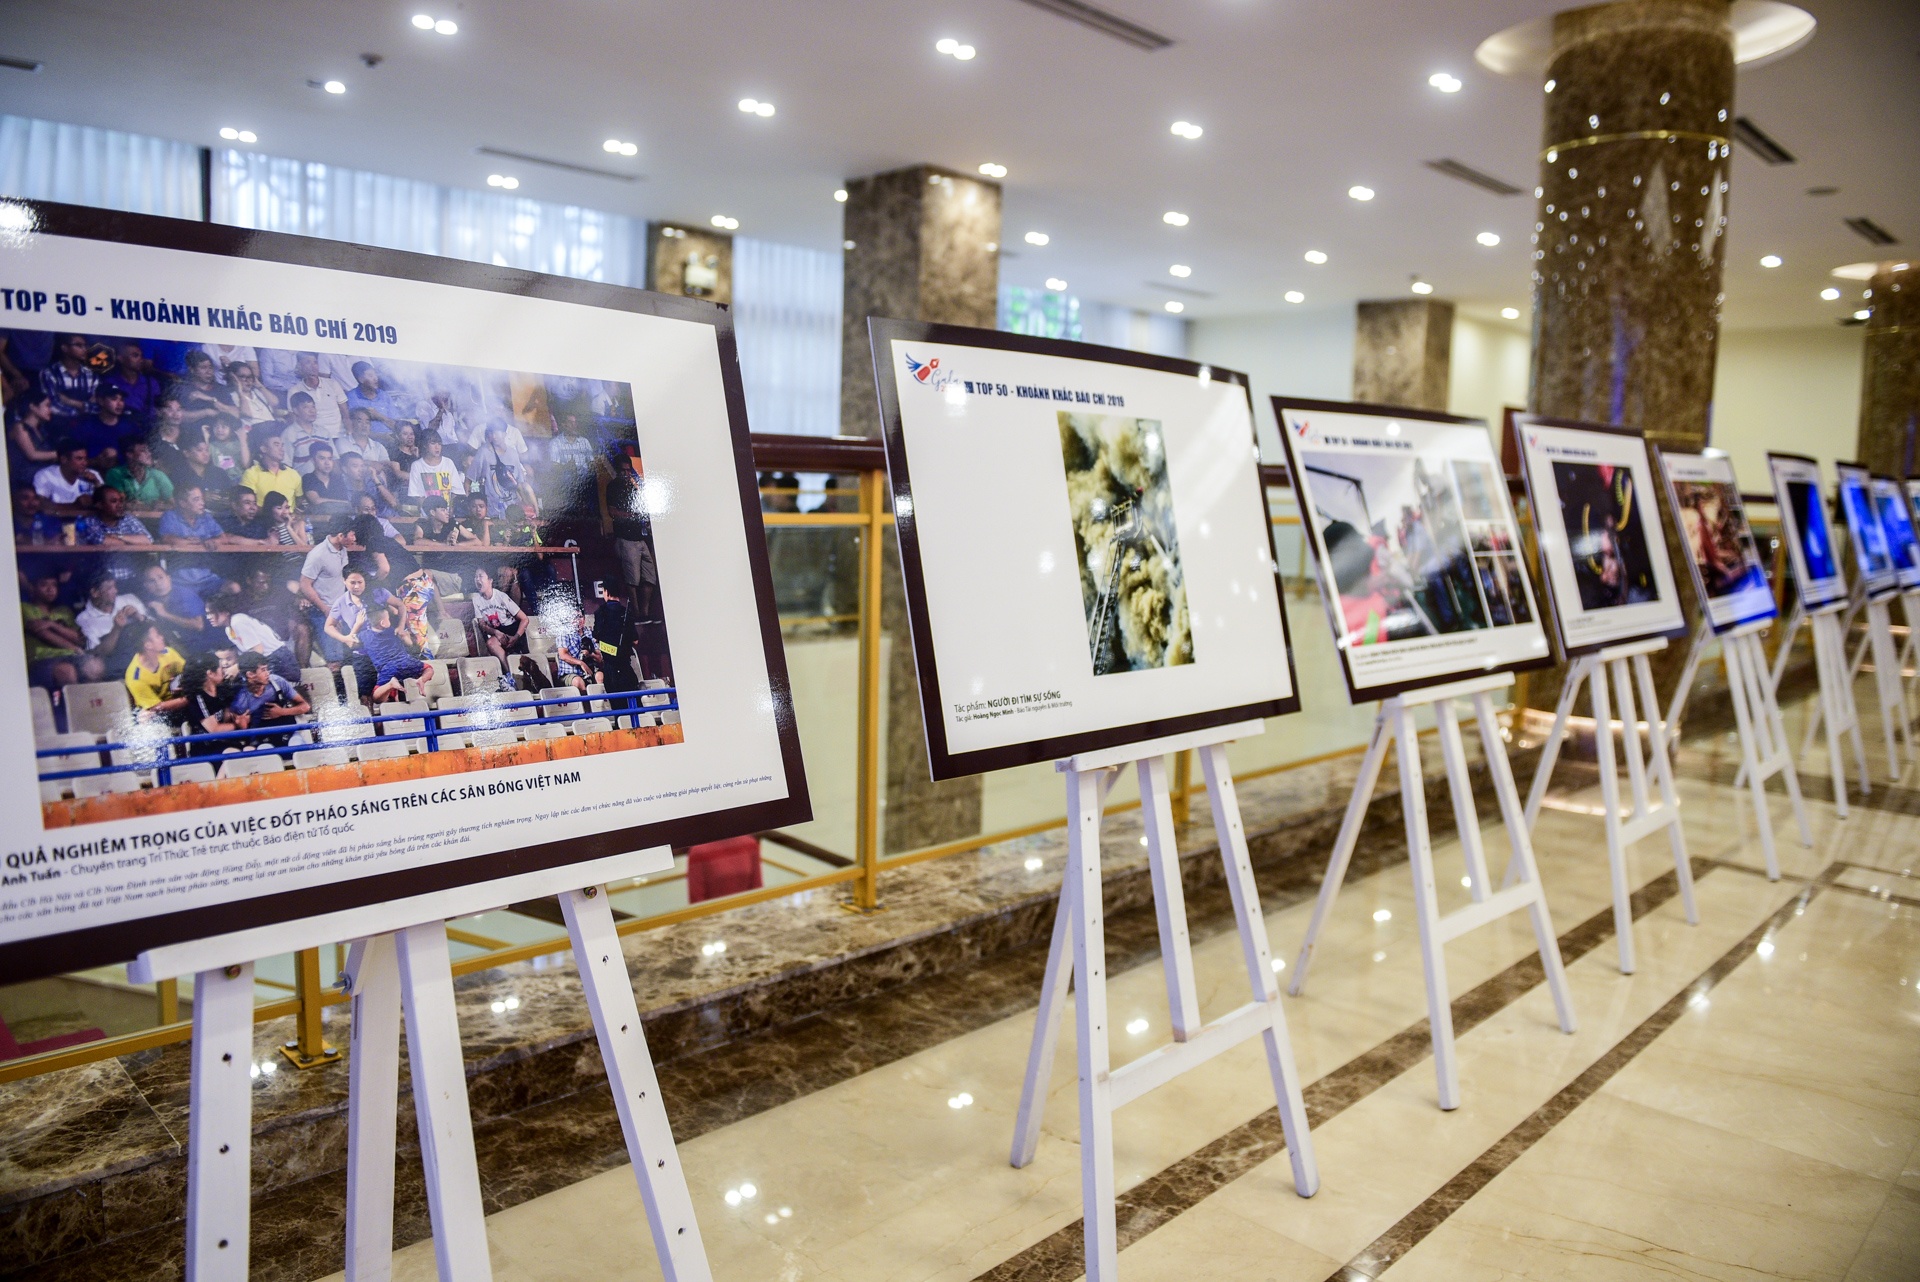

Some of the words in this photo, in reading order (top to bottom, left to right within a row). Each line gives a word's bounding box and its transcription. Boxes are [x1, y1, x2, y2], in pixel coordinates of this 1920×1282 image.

[0, 288, 47, 313] TOP
[55, 293, 87, 316] 50
[110, 297, 200, 326] KHOẢNH
[207, 304, 263, 331] KHẮC
[269, 312, 309, 336] BÁO
[314, 318, 348, 340] CHÍ
[353, 322, 398, 344] 2019
[976, 382, 994, 395] TOP
[996, 383, 1008, 396] 50
[1108, 394, 1124, 407] 2019
[954, 704, 964, 713] Tác
[966, 701, 986, 713] phẩm:
[987, 697, 1010, 708] NGƯỜI
[1011, 696, 1020, 705] ĐI
[1020, 694, 1032, 704] TÌM
[1034, 692, 1042, 703] SỰ
[1043, 690, 1061, 701] SỐNG
[973, 711, 990, 720] Hoàng
[990, 710, 1001, 718] Ngọc
[6, 845, 47, 869] QUẢ
[52, 838, 126, 861] NGHIÊM
[130, 829, 190, 850] TRỌNG
[194, 821, 228, 840] CỦA
[231, 816, 267, 835] VIỆC
[270, 809, 302, 828] ĐỐT
[306, 805, 348, 823] PHÁO
[351, 800, 390, 817] SÁNG
[392, 793, 428, 810] TRÊN
[431, 788, 457, 804] CÁC
[460, 784, 486, 800] SÂN
[488, 780, 524, 796] BÓNG
[525, 774, 551, 791] VIỆT
[554, 771, 582, 786] NAM
[1, 872, 27, 887] Anh
[30, 867, 61, 882] Tuấn
[70, 859, 115, 876] Chuyên
[116, 855, 147, 869] trang
[149, 852, 163, 864] Trí
[164, 849, 189, 862] Thức
[191, 844, 207, 857] Trẻ
[209, 843, 230, 856] trực
[231, 839, 261, 851] thuộc
[263, 833, 282, 846] Báo
[283, 829, 305, 843] điện
[306, 826, 318, 837] tử
[319, 823, 330, 836] Tổ
[331, 821, 356, 837] quốc
